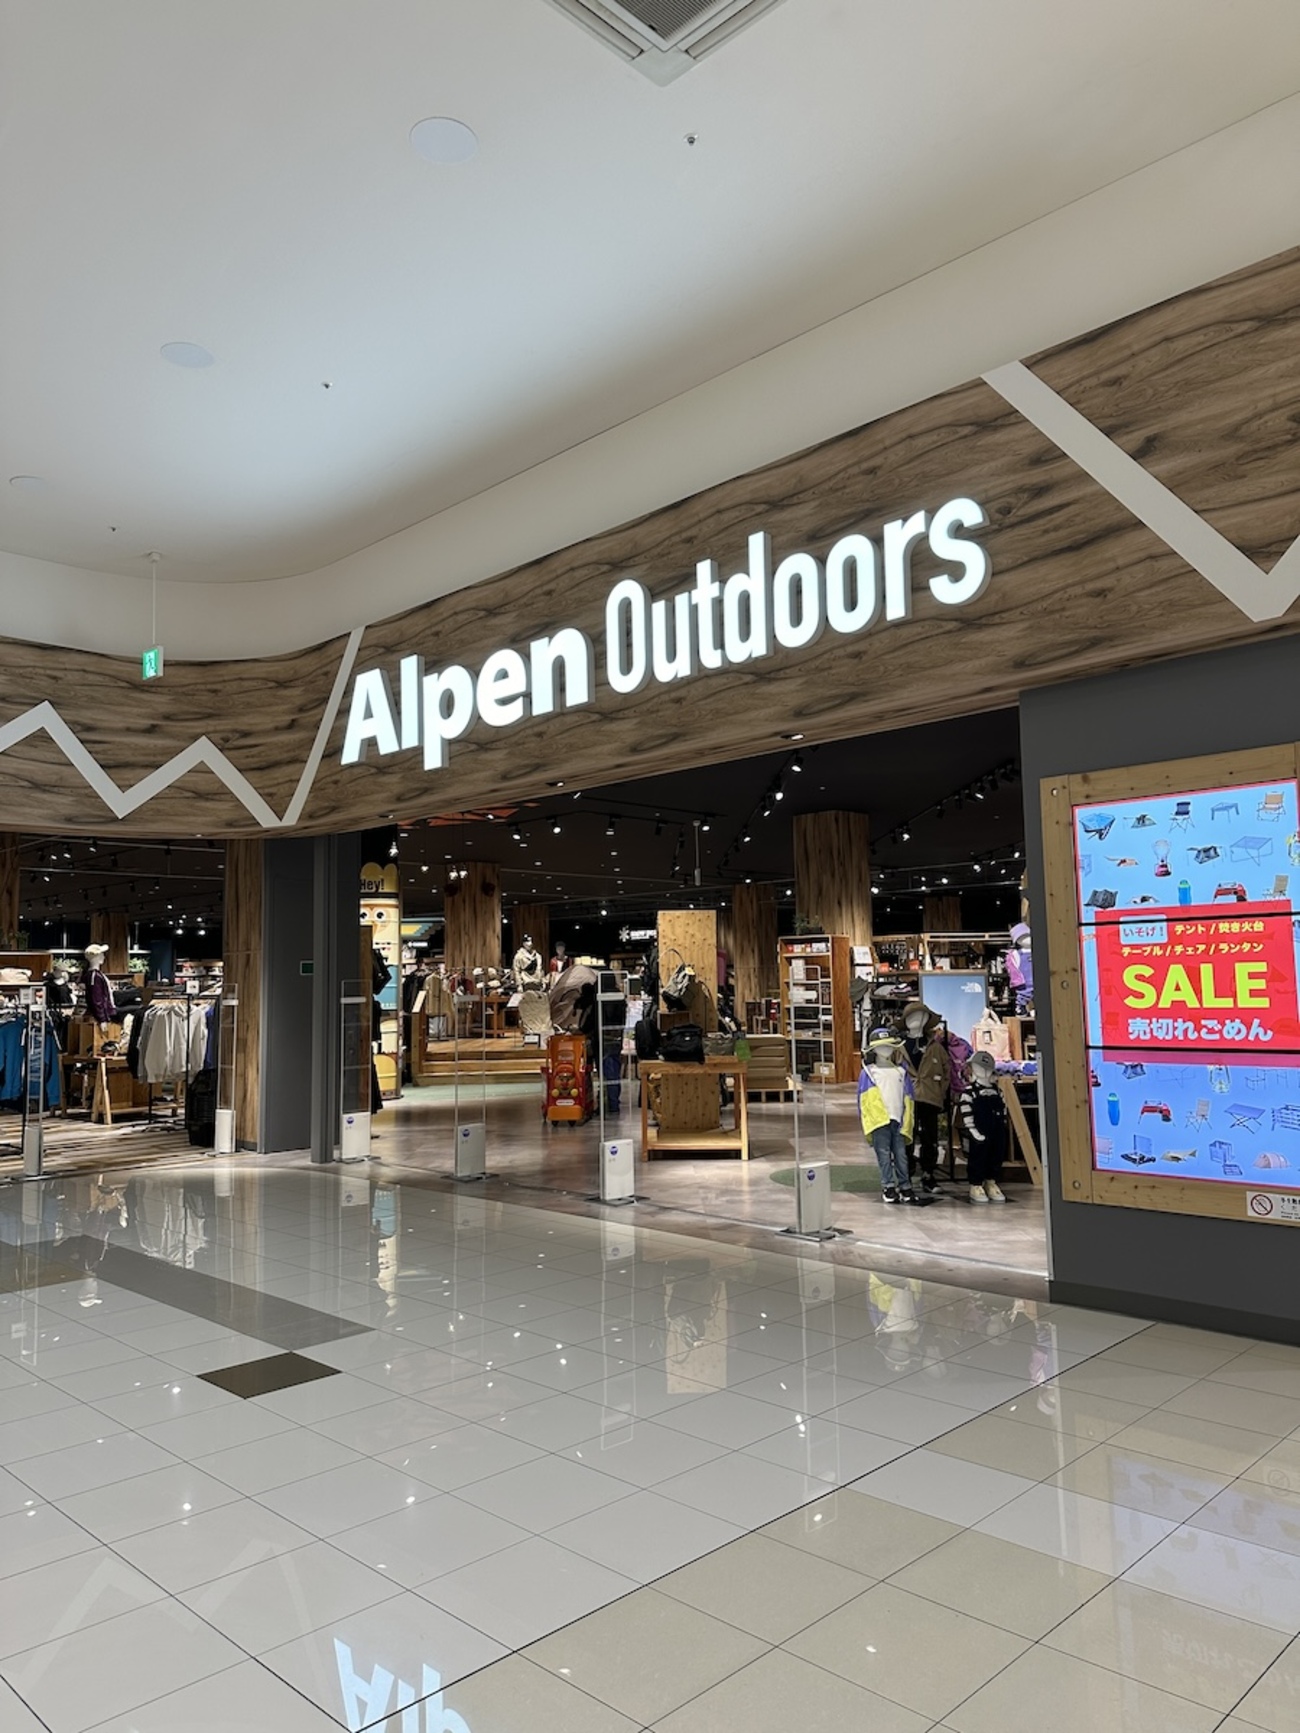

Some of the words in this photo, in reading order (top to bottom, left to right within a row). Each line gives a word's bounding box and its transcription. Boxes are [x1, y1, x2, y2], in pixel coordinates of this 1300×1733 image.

[340, 626, 595, 771] Alpen
[604, 497, 990, 695] Outdoors
[1123, 962, 1270, 1009] SALE
[1128, 1017, 1273, 1041] 売切れごめん
